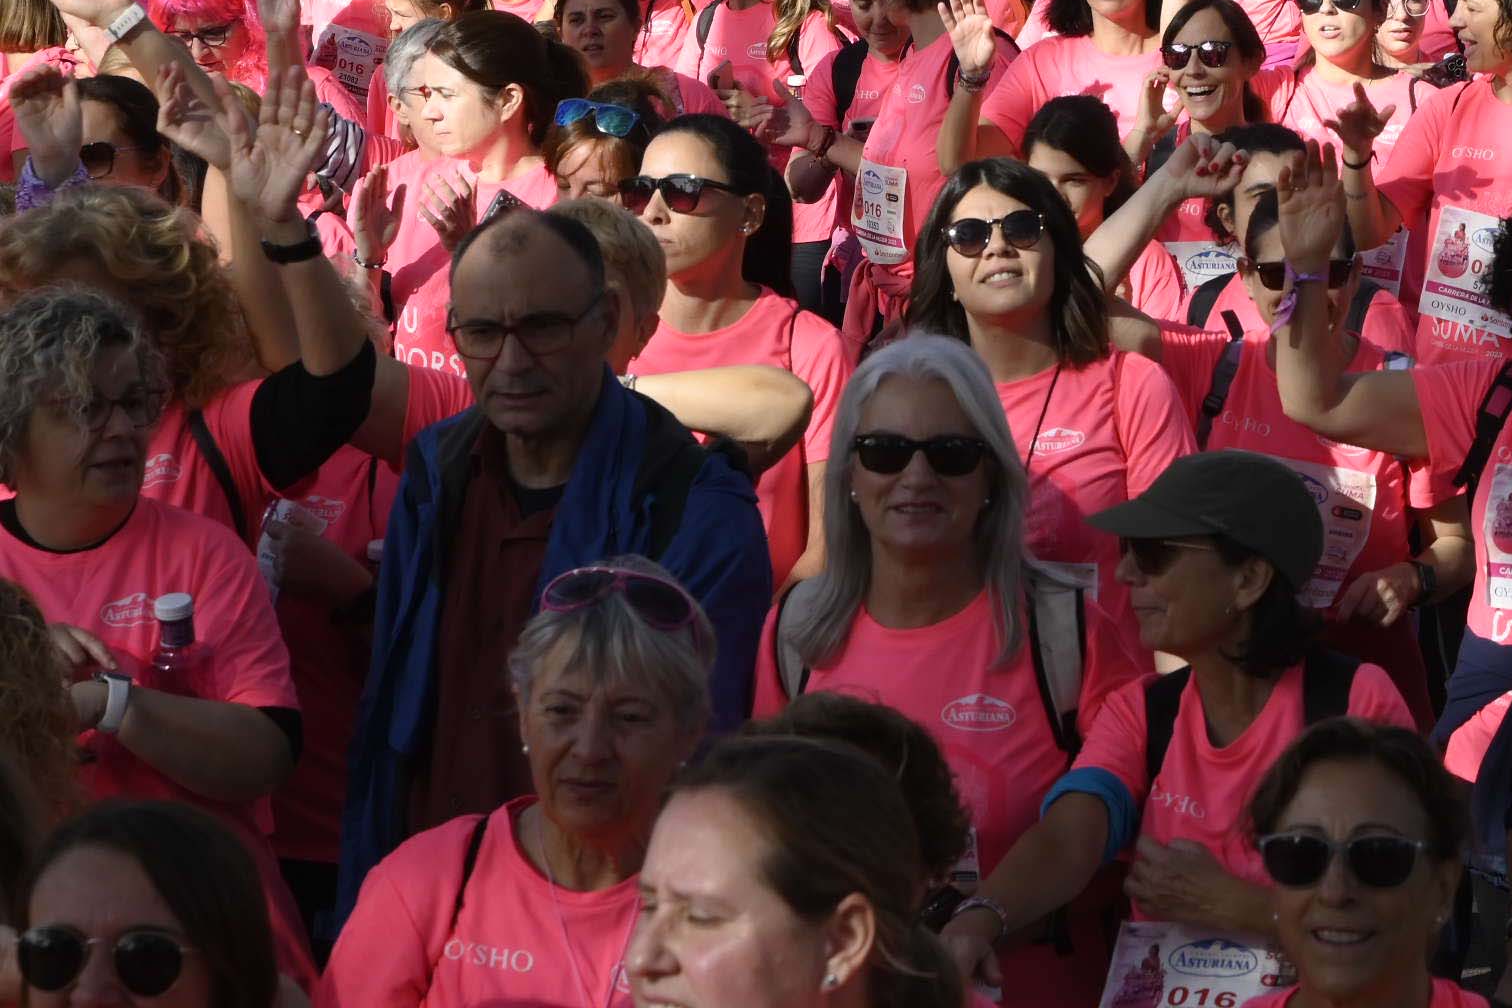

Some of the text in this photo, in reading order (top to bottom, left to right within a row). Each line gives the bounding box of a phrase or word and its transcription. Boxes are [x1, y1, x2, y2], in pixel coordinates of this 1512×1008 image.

[339, 58, 365, 75] 016
[864, 200, 882, 218] 016
[1190, 259, 1236, 271] ASTURIANA
[1438, 285, 1469, 301] CARRERA
[1431, 298, 1467, 317] OYSHO
[950, 704, 1011, 723] ASTURIANA
[1175, 952, 1251, 971] ASTURIANA
[1167, 986, 1238, 1008] 016
